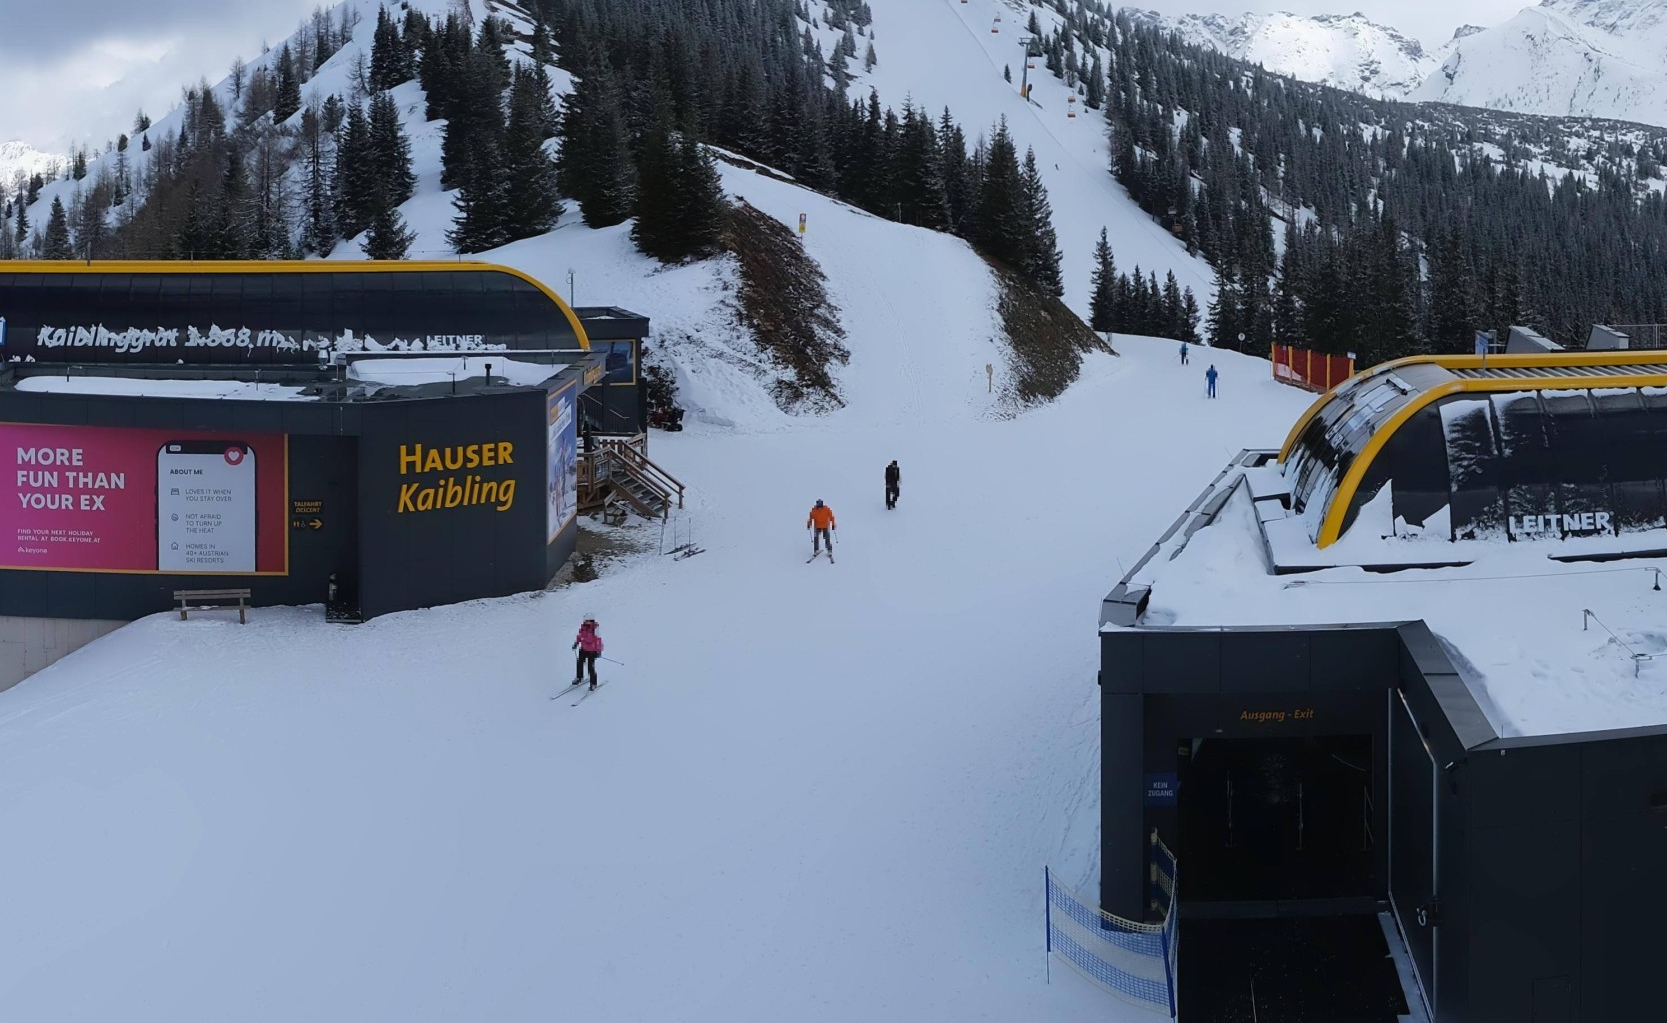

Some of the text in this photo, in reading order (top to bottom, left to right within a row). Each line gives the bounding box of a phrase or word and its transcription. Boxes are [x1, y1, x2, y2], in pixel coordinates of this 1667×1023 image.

[17, 447, 84, 466] MORE
[399, 441, 514, 475] HAUSER
[17, 470, 125, 489] FUN THAN
[18, 492, 105, 511] YOUR EX
[397, 475, 516, 513] Kaibling
[1508, 512, 1611, 533] LEITNER
[1240, 710, 1285, 722] Ausgang
[1294, 709, 1314, 719] Exit
